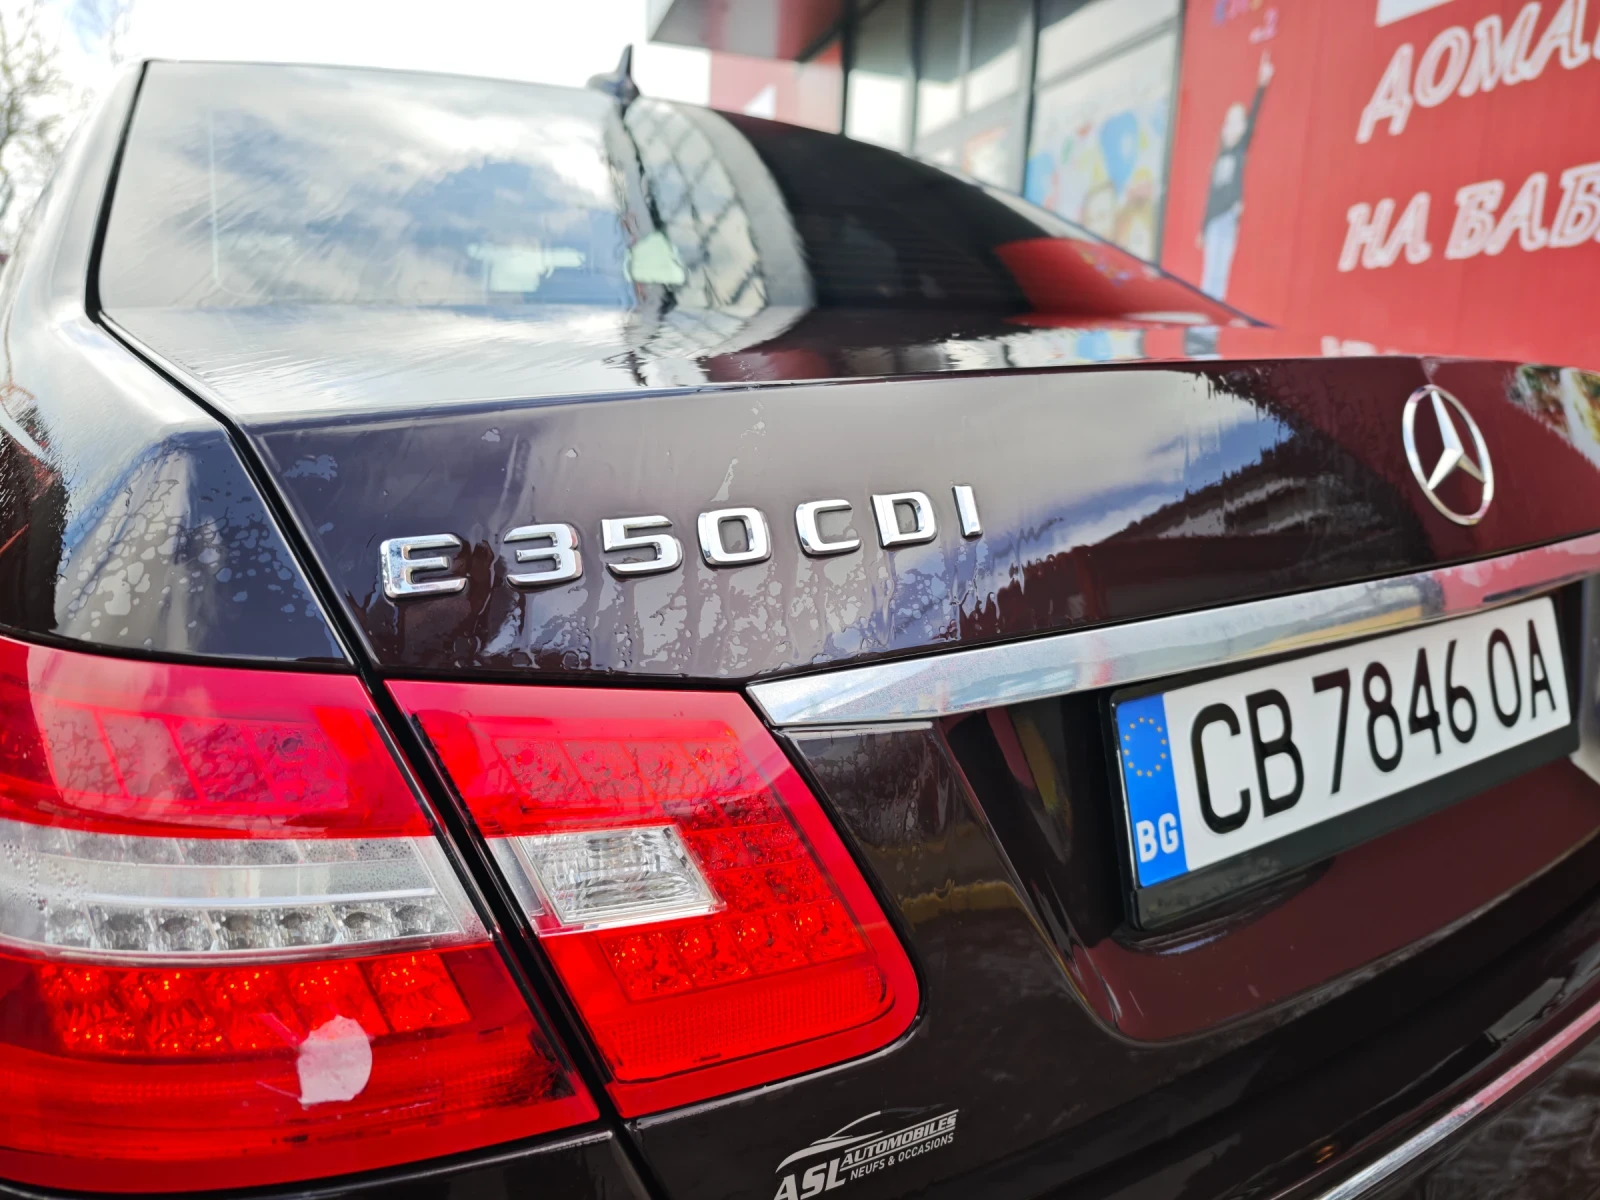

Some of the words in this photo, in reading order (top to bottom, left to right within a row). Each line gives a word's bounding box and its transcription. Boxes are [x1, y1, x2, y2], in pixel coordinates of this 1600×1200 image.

[1356, 0, 1600, 144] ДОМА
[1338, 192, 1432, 272] НА
[1444, 161, 1600, 260] БАБ
[379, 533, 468, 599] E
[1190, 687, 1305, 835] CB
[1311, 639, 1478, 796] 7846
[1487, 618, 1557, 728] OA
[1135, 812, 1180, 864] BG
[840, 1113, 957, 1167] AUTOMOBILES
[850, 1158, 886, 1181] NEUFS
[887, 1155, 896, 1166] &
[898, 1132, 955, 1163] OCCASIONS
[773, 1157, 847, 1200] ASL
